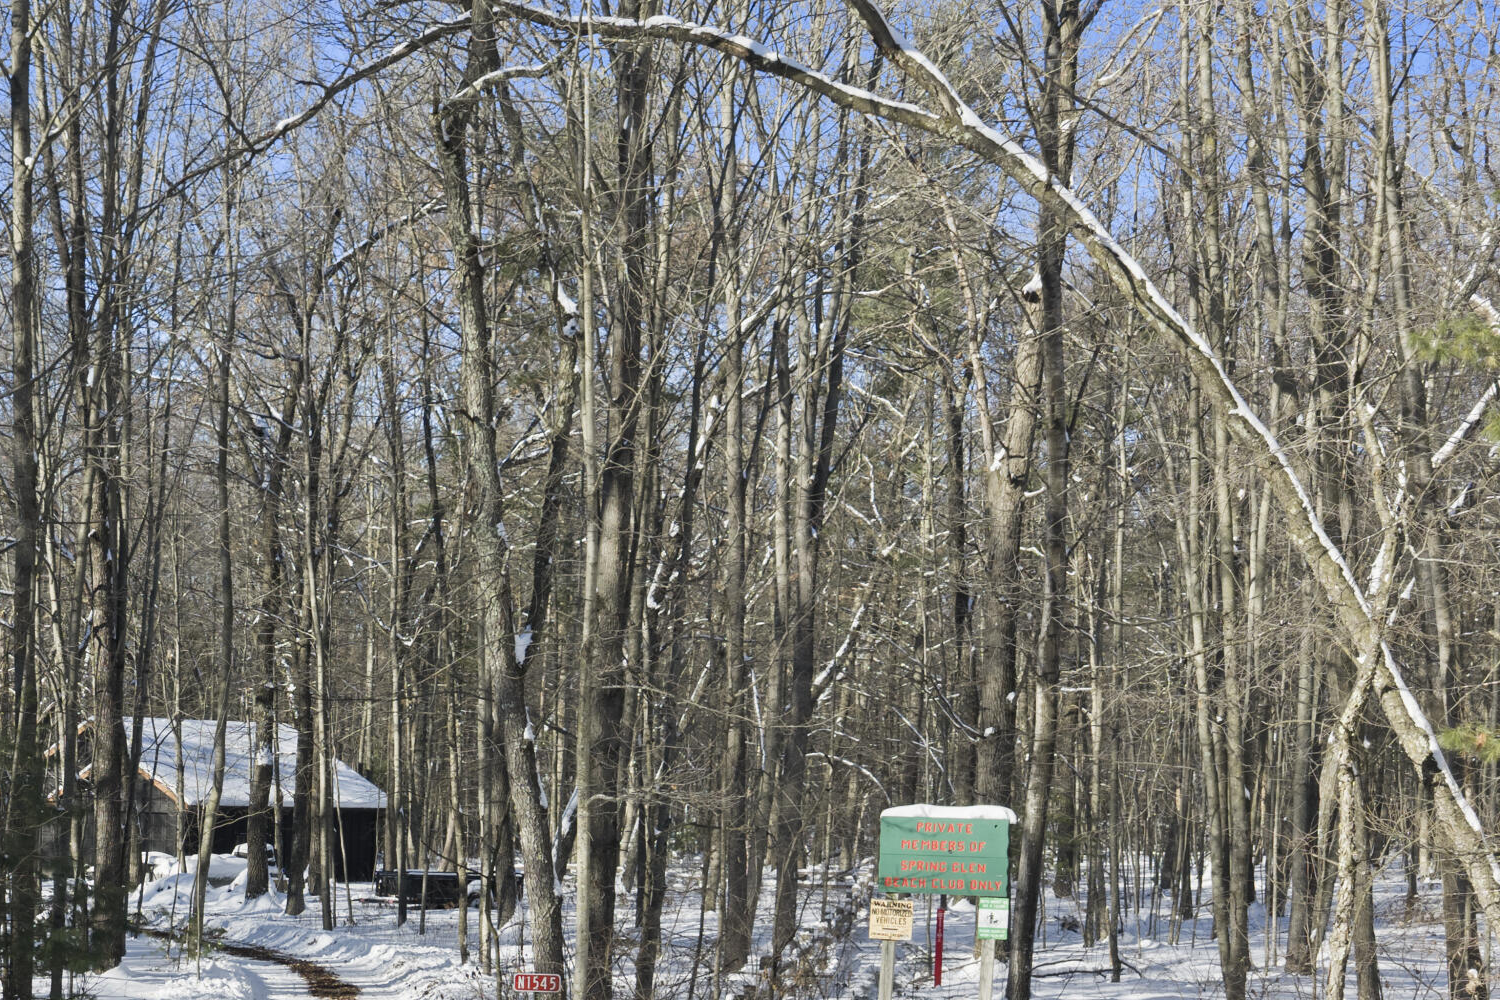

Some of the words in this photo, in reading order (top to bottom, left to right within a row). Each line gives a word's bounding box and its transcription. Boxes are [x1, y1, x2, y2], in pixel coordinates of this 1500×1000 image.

[916, 822, 973, 834] PRIVATE
[901, 839, 965, 852] MEMBERS
[969, 841, 987, 852] OF
[901, 860, 947, 872] SPRING
[952, 862, 987, 873] GLEN
[884, 877, 926, 888] BEACH
[931, 878, 964, 890] CLUB
[970, 880, 1002, 891] ONLY
[876, 917, 907, 926] VEHICLES
[518, 976, 556, 990] N1545
